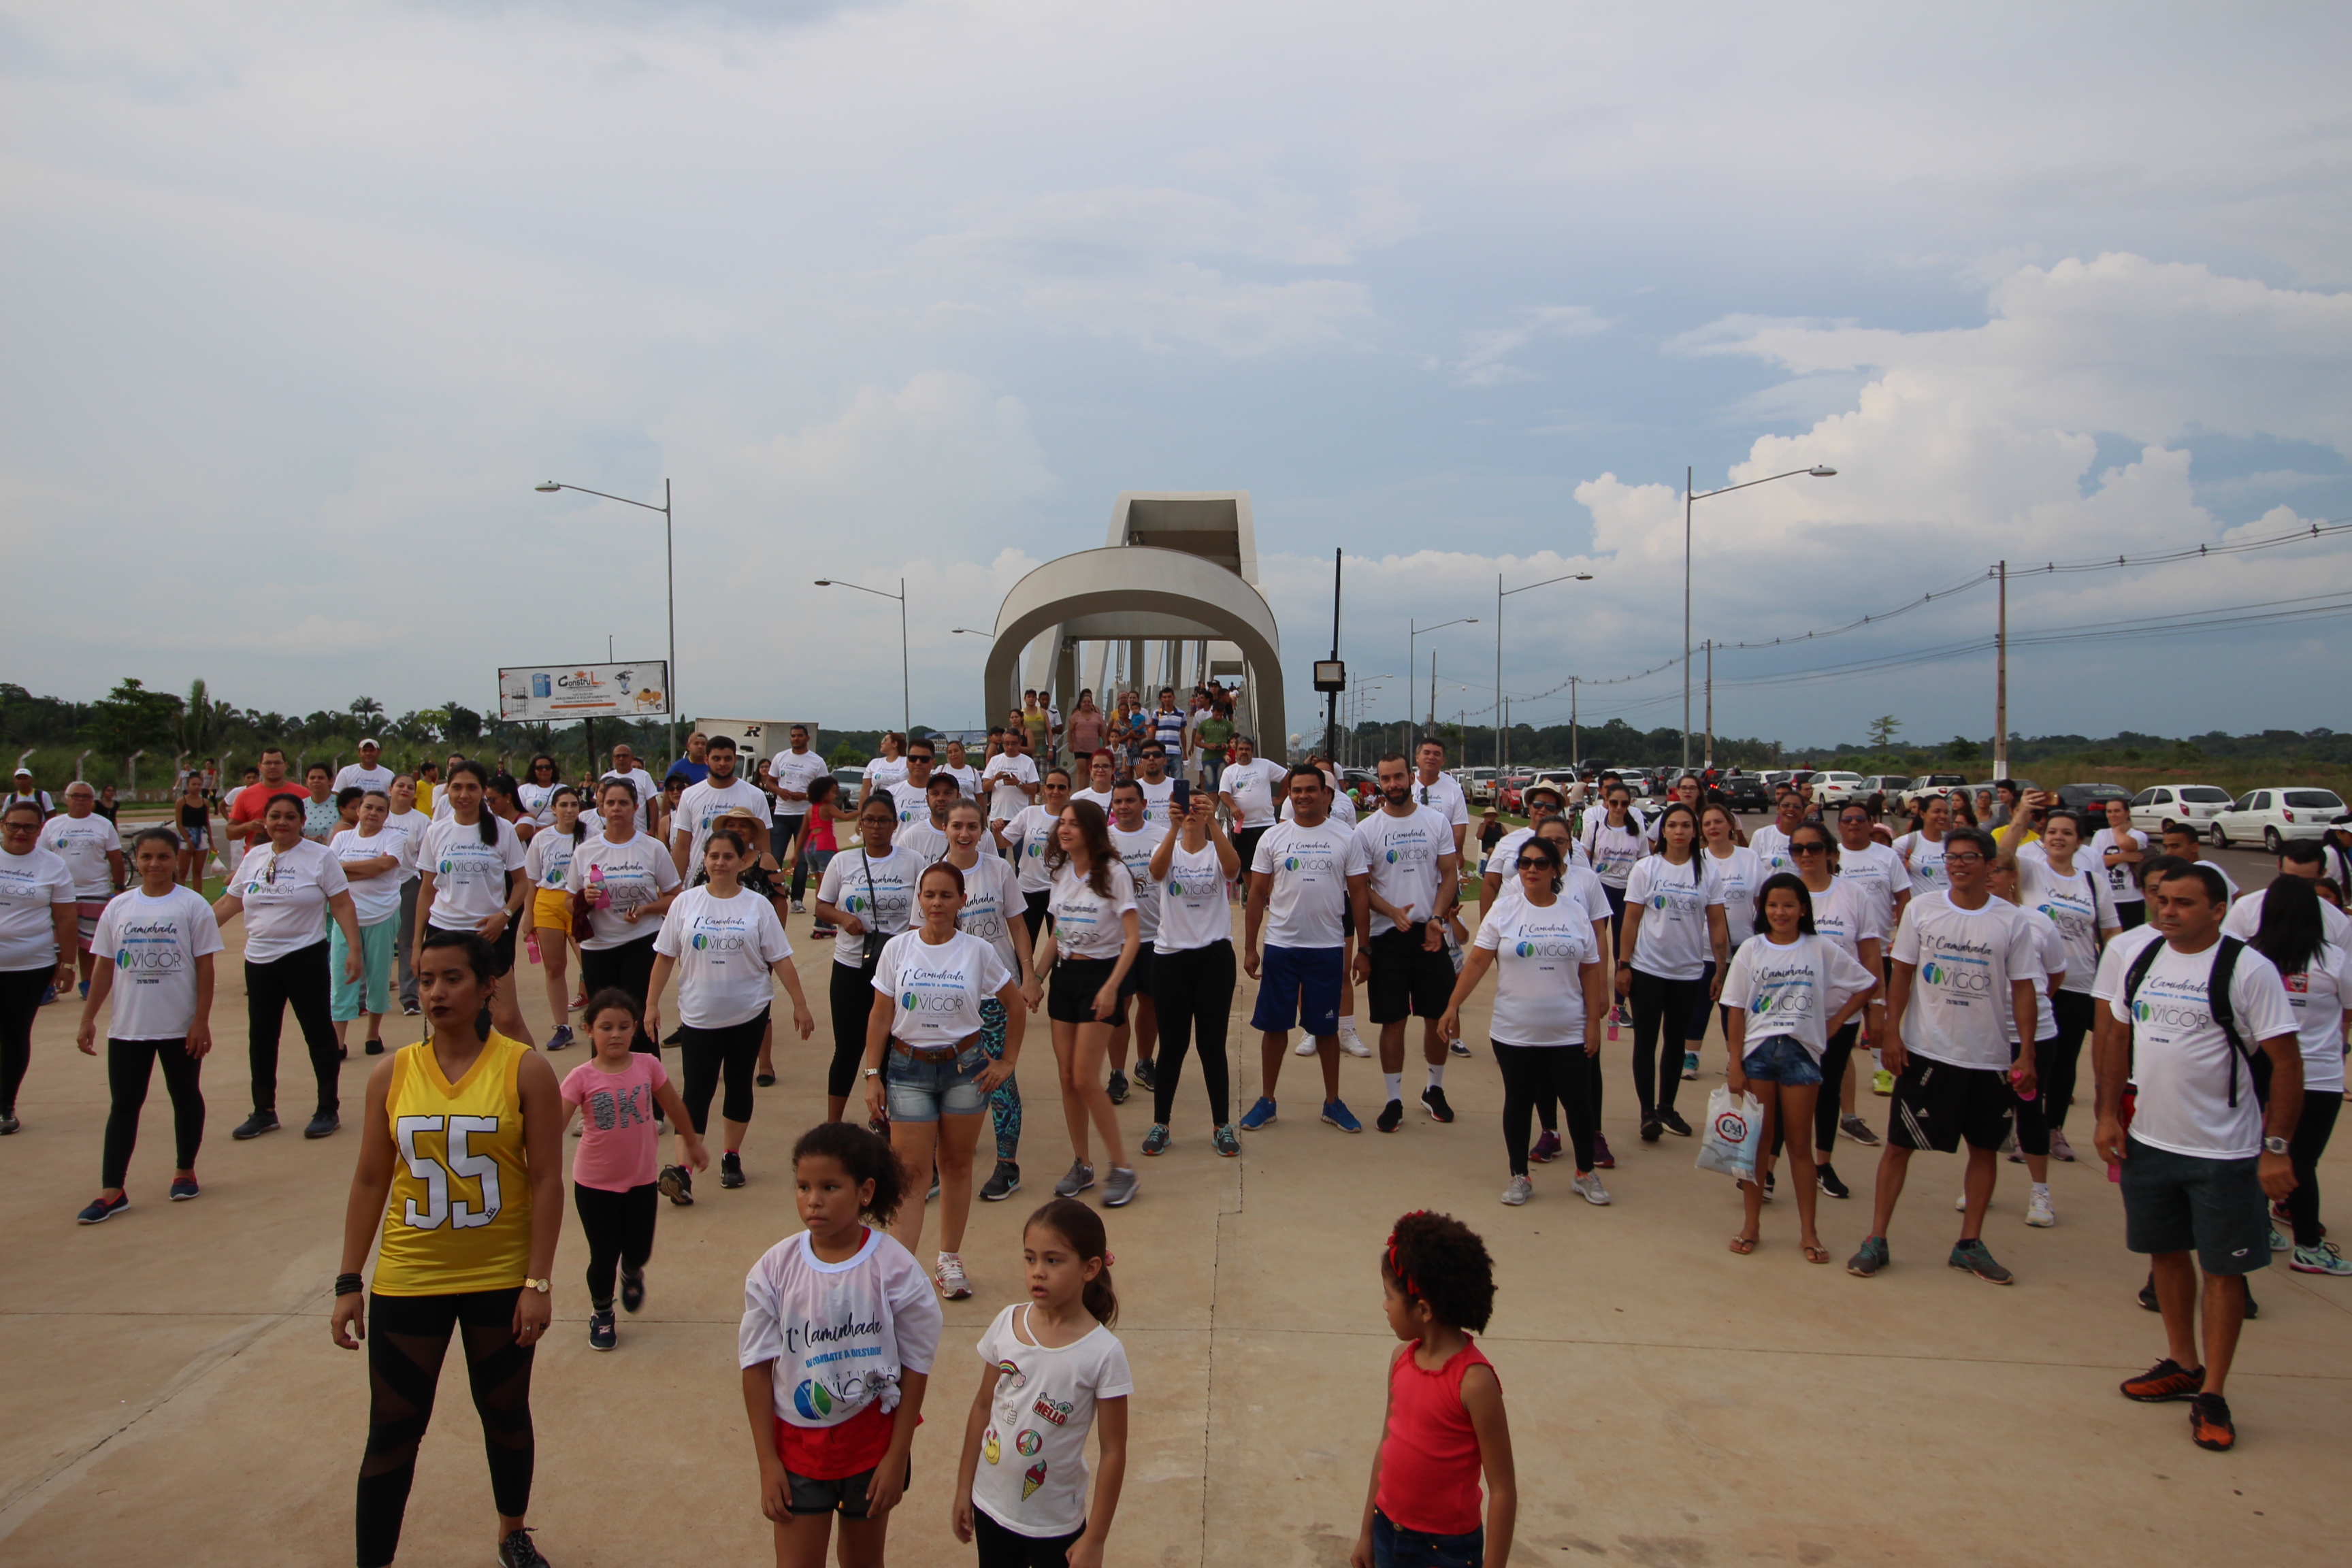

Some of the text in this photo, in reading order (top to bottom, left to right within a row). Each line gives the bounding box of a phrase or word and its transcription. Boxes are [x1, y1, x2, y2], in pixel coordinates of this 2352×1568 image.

[1392, 829, 1426, 840] Caminhada
[451, 842, 489, 851] Caminhada
[1296, 840, 1330, 849] Caminhada
[1399, 849, 1428, 860] VIGOR
[1604, 847, 1633, 856] Caminhada
[454, 862, 489, 874] VIGOR
[600, 861, 644, 872] Caminhada
[1300, 860, 1333, 871] VIGOR
[0, 869, 34, 878] aminhada
[260, 884, 295, 894] VIGOR
[1183, 883, 1218, 895] VIGOR
[864, 898, 907, 911] VGOR
[1667, 898, 1697, 912] VIGOR
[705, 916, 745, 925] Caminhada
[125, 921, 178, 935] Caminhada
[1529, 924, 1569, 932] Caminhada
[1535, 945, 1576, 957] VIGOR
[1936, 936, 1993, 956] Caminhada
[131, 952, 181, 967] VIGOR
[913, 968, 965, 981] Caminhada
[1761, 964, 1814, 980] Caminhada
[2151, 976, 2209, 993] Caminhada
[919, 996, 964, 1011] VIGOR
[1770, 995, 1813, 1012] VIGOR
[2151, 1007, 2209, 1029] VIGOR
[1920, 1066, 1933, 1086] adidas
[1722, 1119, 1743, 1137] C&A
[396, 1114, 502, 1230] 55
[485, 1207, 497, 1220] XXL
[844, 1349, 851, 1358] A
[1034, 1400, 1067, 1425] HELLO
